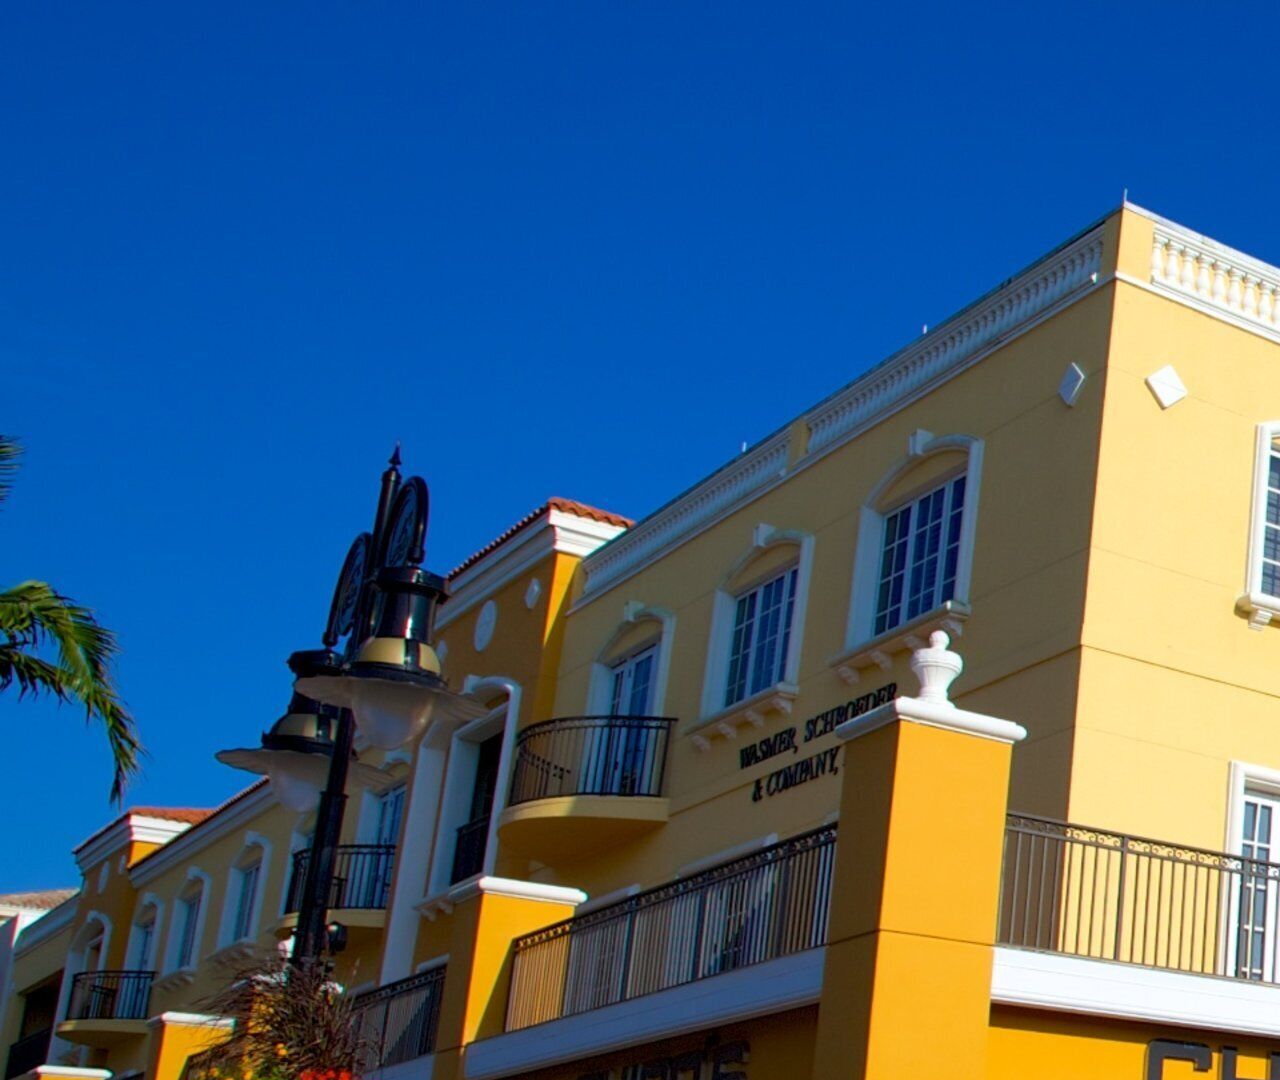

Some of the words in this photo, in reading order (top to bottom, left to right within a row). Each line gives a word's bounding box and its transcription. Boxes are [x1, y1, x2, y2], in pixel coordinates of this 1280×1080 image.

[740, 726, 798, 769] WASMER,
[804, 682, 898, 743] SCHROEDER
[752, 779, 764, 803] &
[766, 745, 841, 797] COMPANY,
